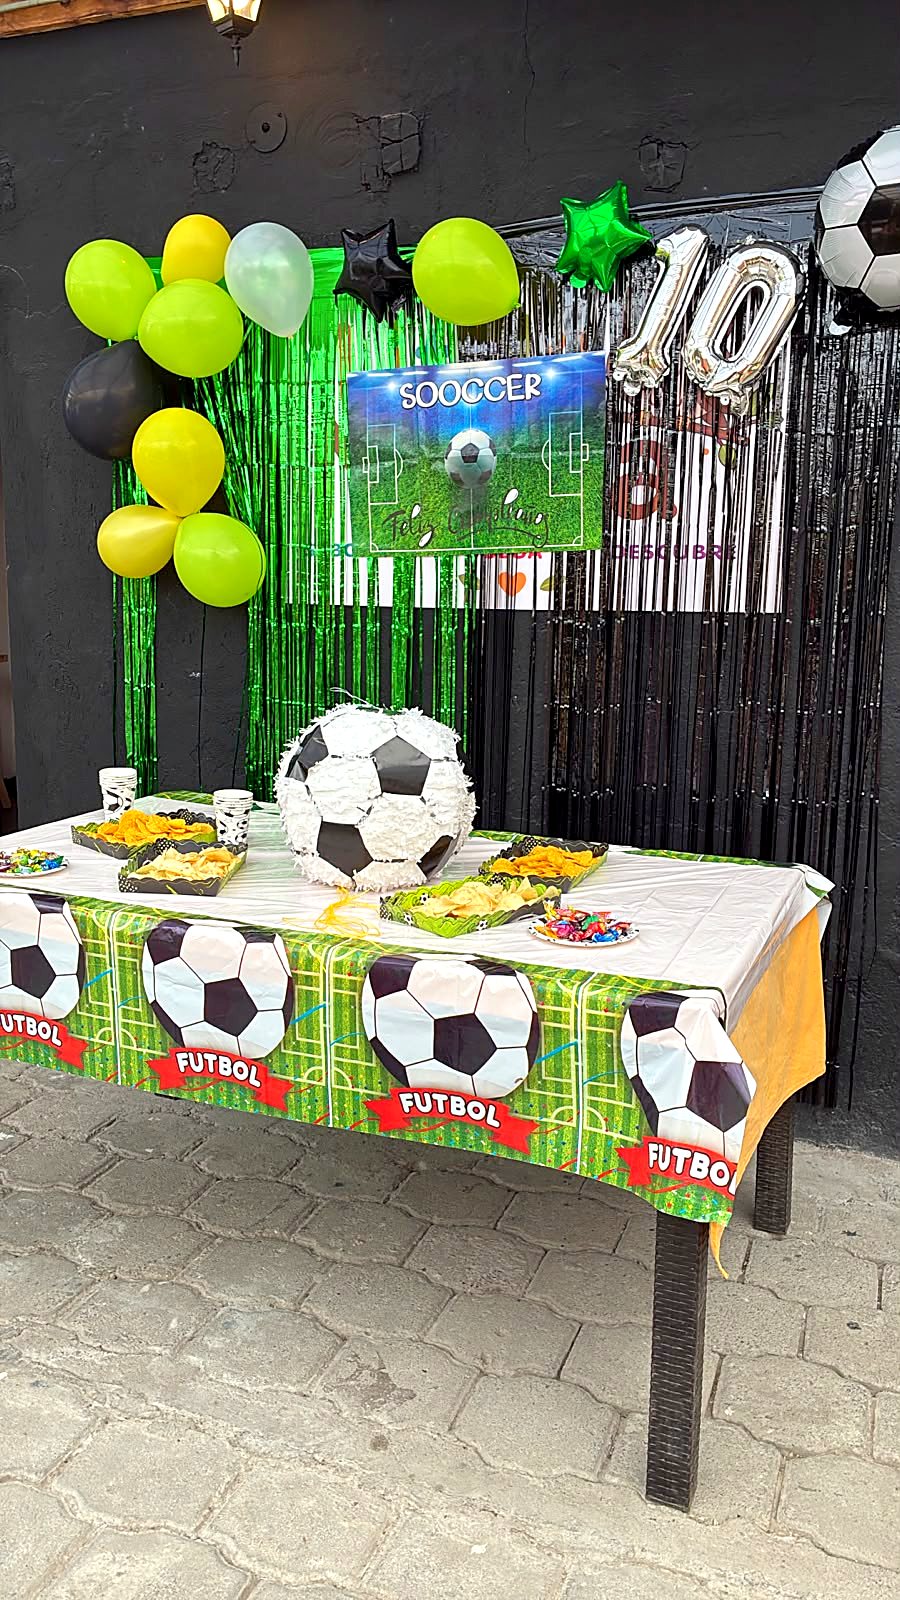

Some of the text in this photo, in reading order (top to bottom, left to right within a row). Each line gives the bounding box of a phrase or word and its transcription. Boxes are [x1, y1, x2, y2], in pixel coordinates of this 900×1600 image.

[612, 224, 805, 398] 10
[399, 373, 541, 410] SOOCCER
[382, 503, 441, 548] Feliz
[0, 1013, 63, 1047] UTBOL
[175, 1051, 262, 1088] FUTBOL
[399, 1092, 501, 1128] FUTBOL
